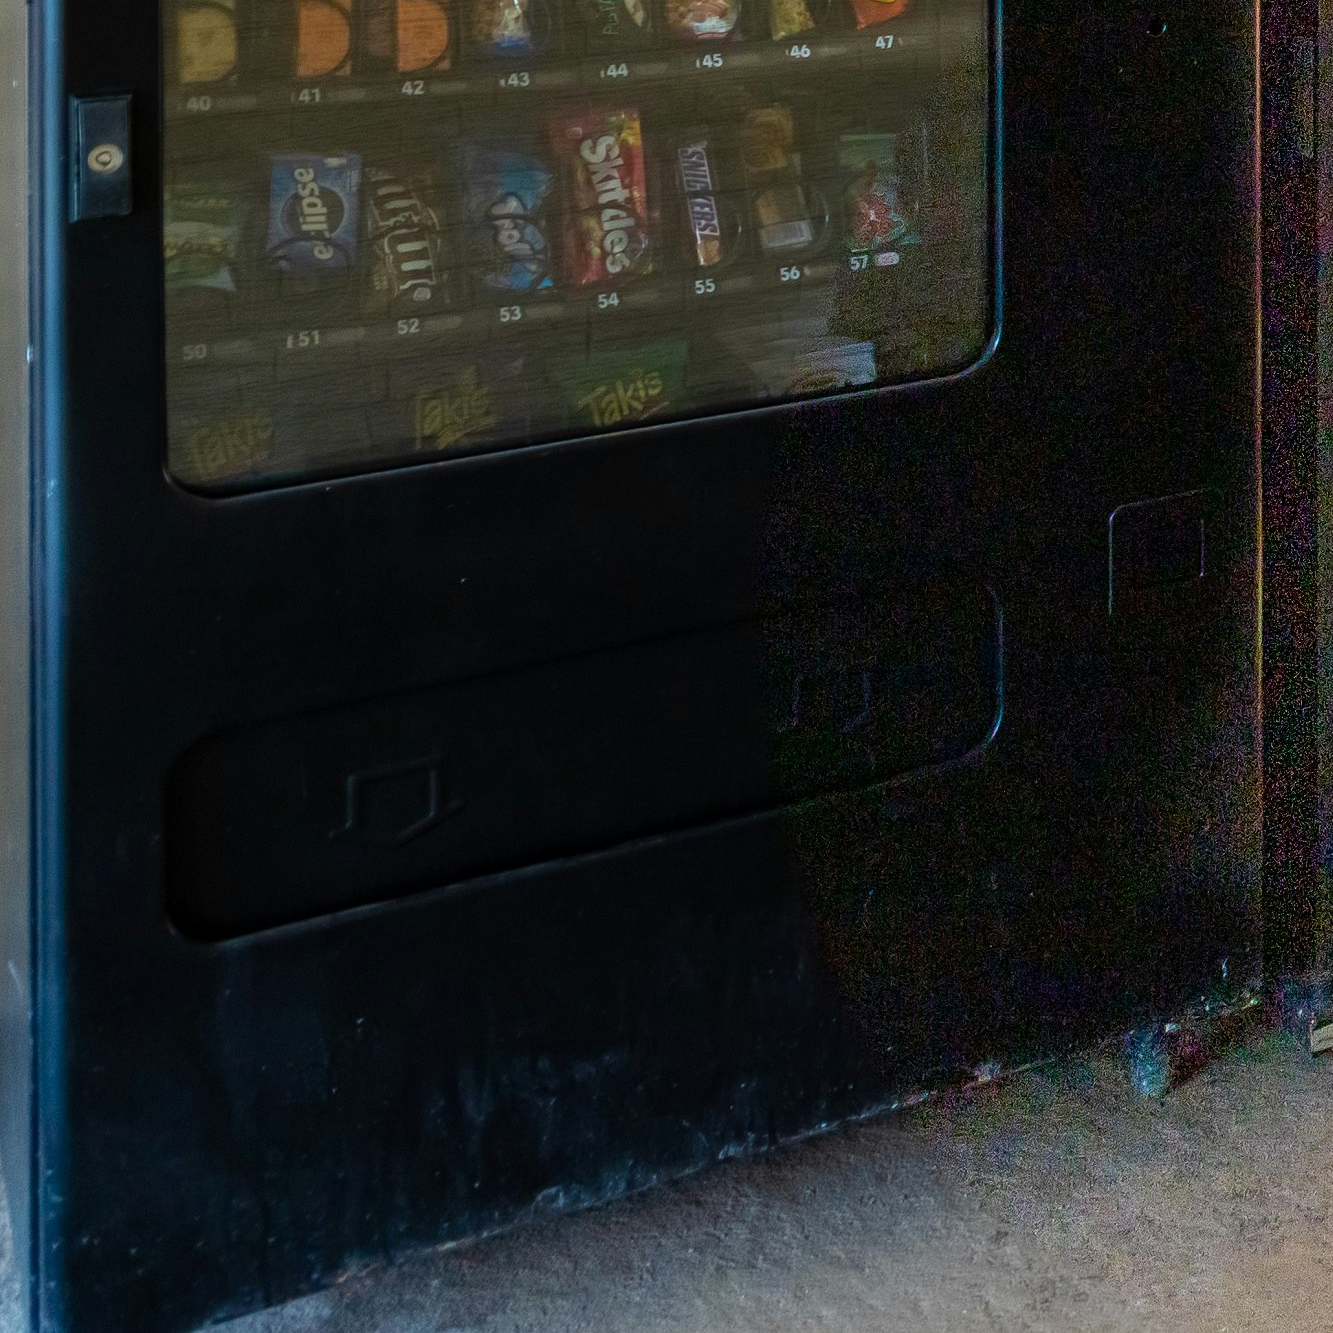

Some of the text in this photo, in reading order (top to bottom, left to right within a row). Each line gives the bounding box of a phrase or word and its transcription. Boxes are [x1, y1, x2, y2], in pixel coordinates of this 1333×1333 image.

[874, 35, 894, 49] 47
[789, 44, 812, 59] 46
[701, 53, 724, 67] 45
[606, 63, 629, 77] 44
[507, 72, 530, 86] 43
[401, 80, 425, 95] 42
[187, 95, 211, 111] 40
[298, 88, 321, 103] 41
[678, 145, 720, 237] SNICERS
[580, 135, 636, 274] Skitles
[849, 255, 868, 270] 57
[780, 267, 800, 282] 56
[694, 280, 716, 295] 55
[597, 293, 620, 308] 54
[500, 306, 522, 322] 53
[397, 319, 420, 334] 52
[298, 330, 321, 347] 51
[183, 344, 208, 360] 50
[578, 369, 664, 427] Takis
